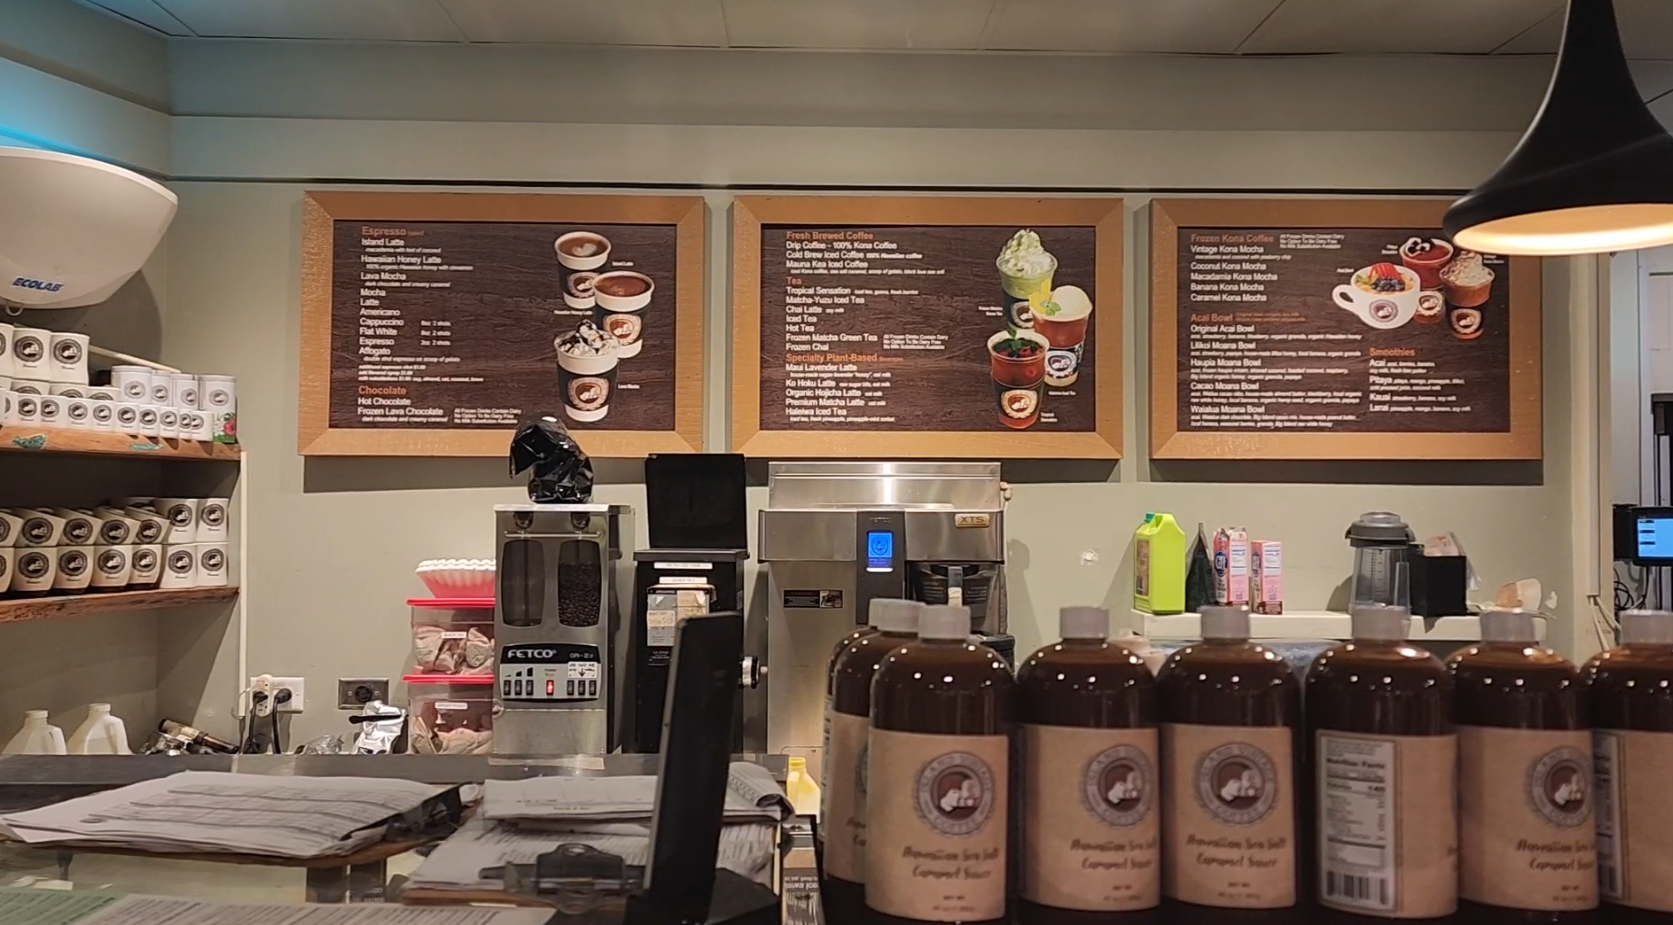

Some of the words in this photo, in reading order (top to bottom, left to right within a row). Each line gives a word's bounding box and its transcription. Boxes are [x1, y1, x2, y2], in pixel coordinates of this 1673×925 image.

[362, 227, 406, 236] Espresso
[362, 238, 384, 246] Island
[386, 238, 404, 246] Latte
[786, 242, 800, 250] Drip
[1191, 246, 1217, 254] Vintage
[398, 256, 421, 264] Honey
[361, 272, 379, 280] Lava
[12, 278, 63, 292] ECOLAB
[360, 318, 404, 326] Cappuccino
[1191, 314, 1209, 322] Acai
[1212, 314, 1233, 322] Bowl
[1191, 325, 1218, 333] Original
[360, 338, 394, 346] Espresso
[359, 347, 390, 356] Affogato
[1370, 348, 1415, 356] Smoothies
[786, 354, 823, 362] Specialty
[1191, 359, 1215, 367] Haupia
[1370, 376, 1392, 384] Pitaya
[359, 386, 406, 394] Chocolate
[815, 389, 841, 397] Hojicha
[1187, 834, 1241, 847] Hawaiian
[1070, 839, 1125, 851] Hawaiian
[1517, 840, 1572, 853] Hawaiian
[903, 846, 958, 860] Hawaiian
[1082, 858, 1126, 870] Caramel
[1197, 854, 1243, 867] Caramel
[1530, 858, 1574, 870] Caramel
[913, 865, 961, 879] Caramel
